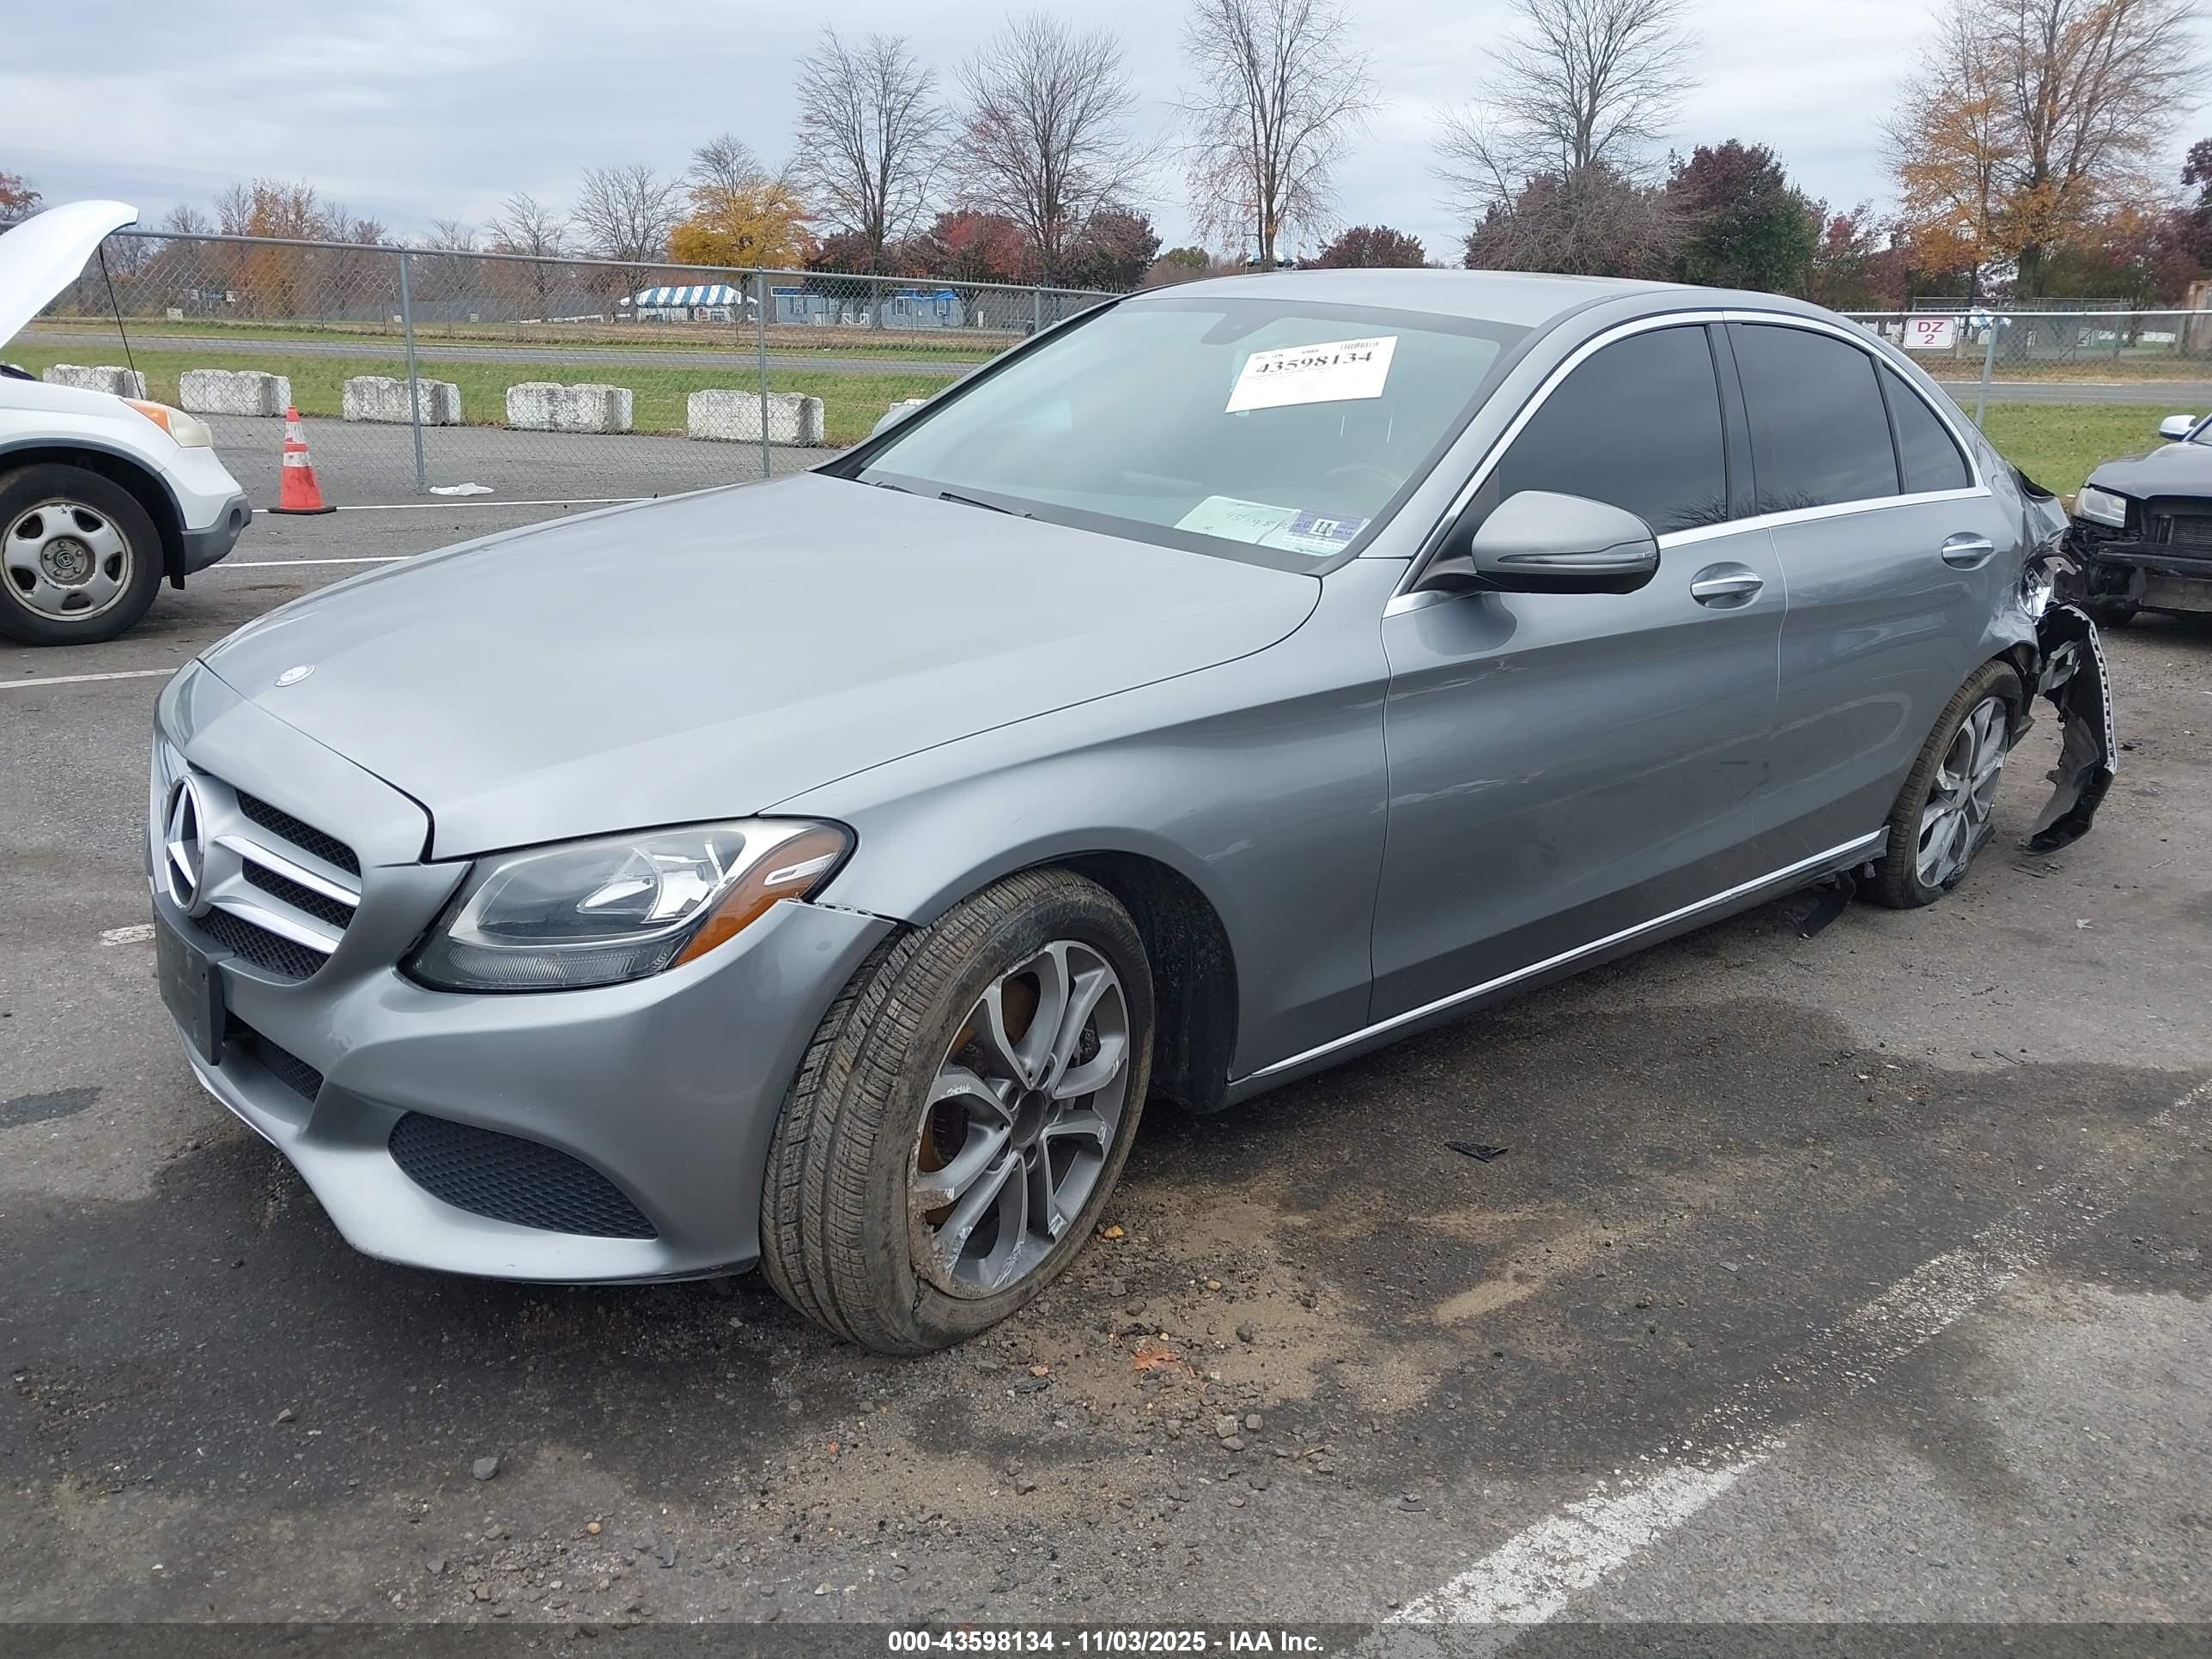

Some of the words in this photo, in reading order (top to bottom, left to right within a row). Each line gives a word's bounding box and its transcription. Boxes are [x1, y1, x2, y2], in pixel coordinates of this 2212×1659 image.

[1917, 321, 1945, 333] DZ
[1923, 333, 1936, 344] 2
[1255, 350, 1373, 374] 43598134
[1313, 520, 1333, 535] 11
